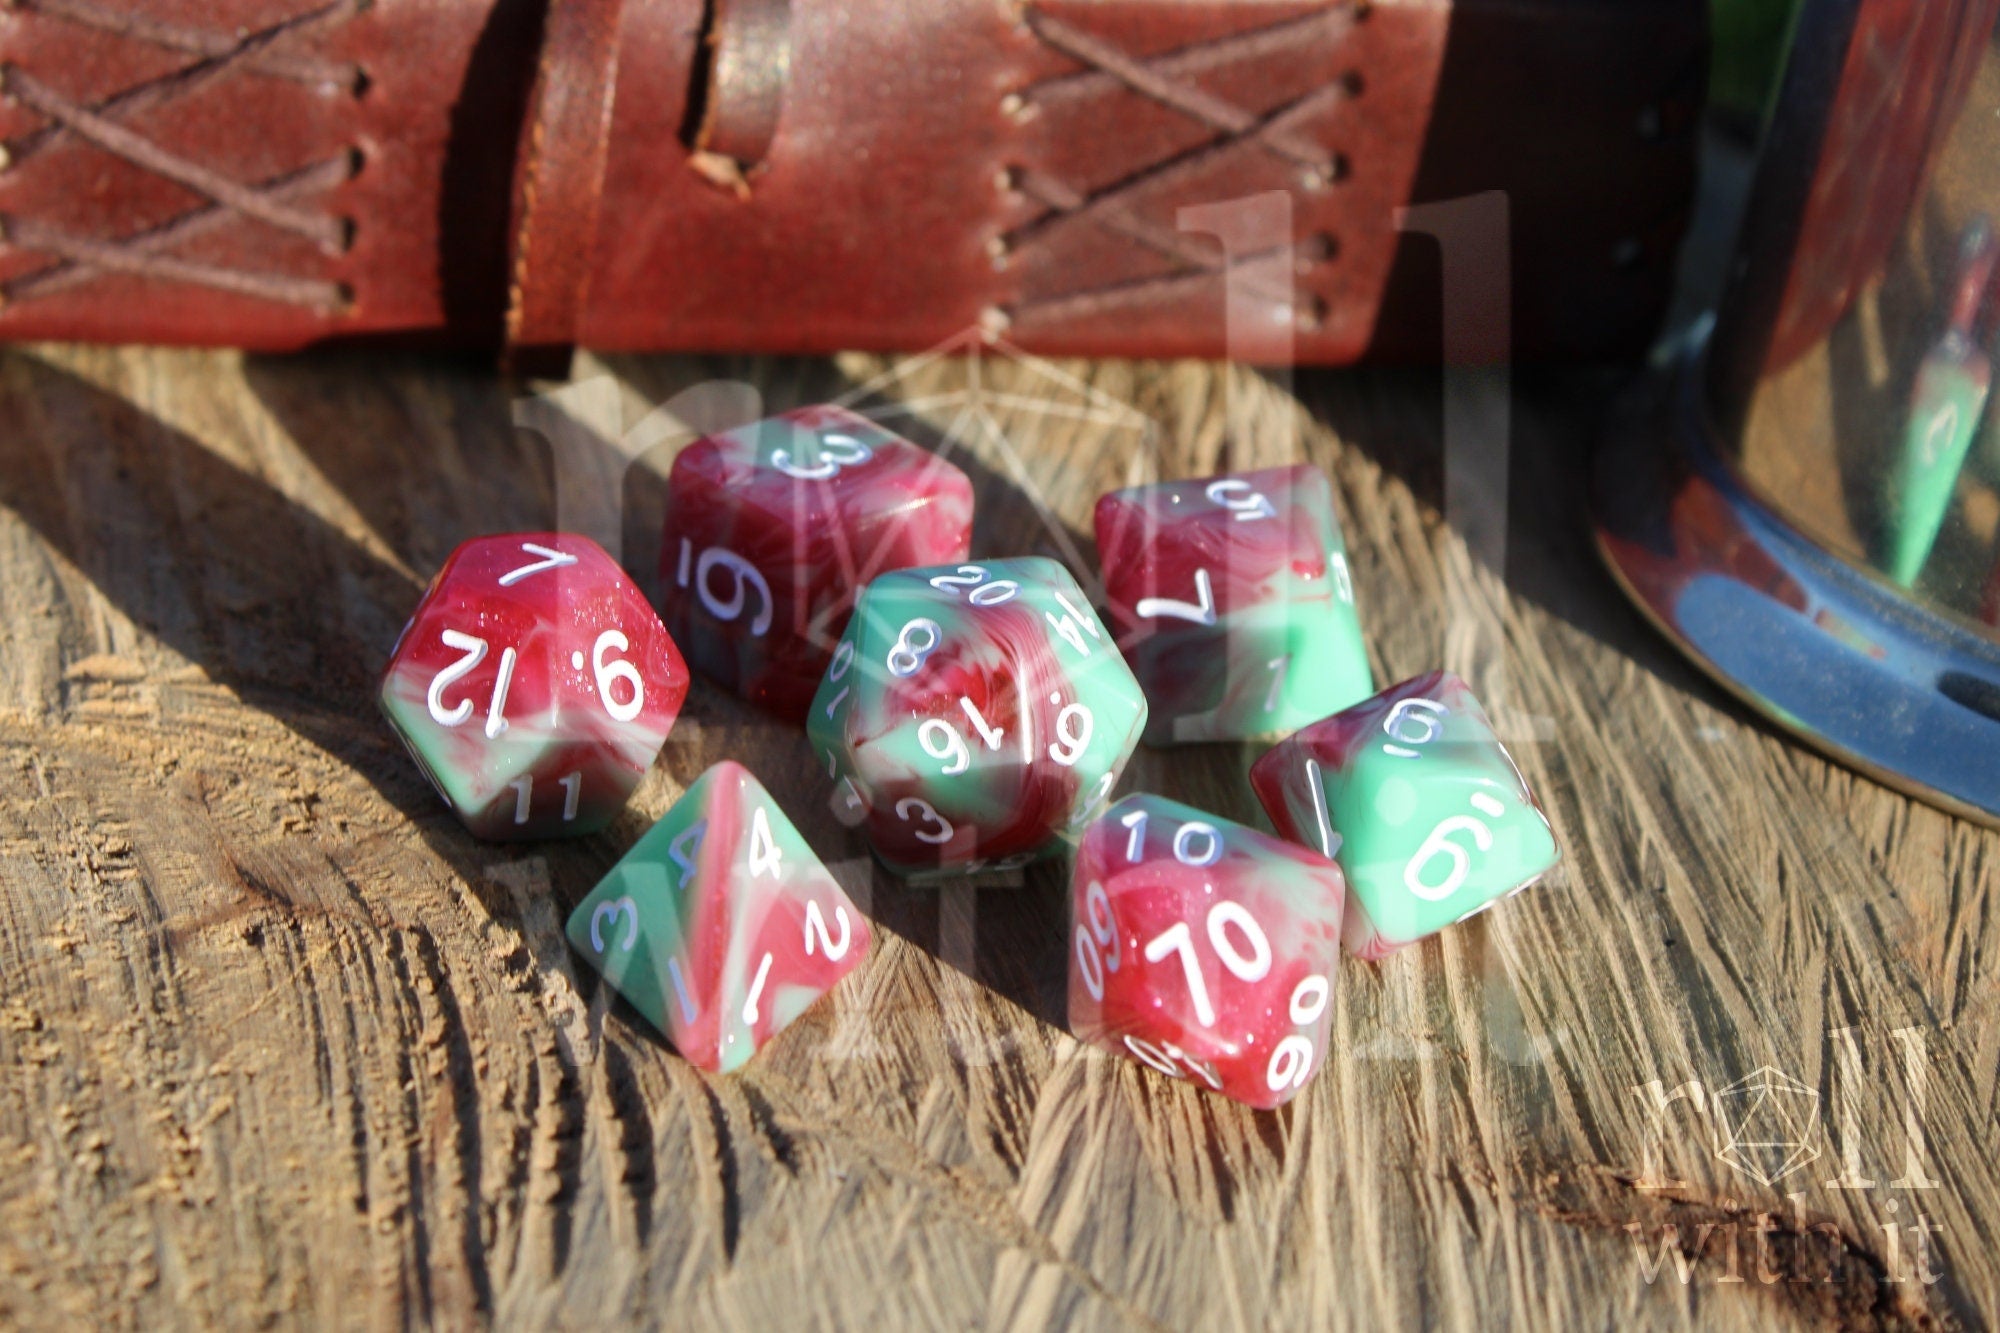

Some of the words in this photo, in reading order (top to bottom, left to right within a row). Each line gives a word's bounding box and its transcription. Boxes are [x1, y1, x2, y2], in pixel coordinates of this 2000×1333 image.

[771, 434, 872, 479] 3
[1205, 479, 1278, 521] 5
[498, 542, 578, 586] 7
[929, 565, 1023, 609] 20
[1045, 591, 1099, 657] 14
[1136, 568, 1218, 626] 7
[887, 618, 942, 677] 8
[427, 628, 516, 739] 12
[918, 697, 1004, 775] 16
[509, 771, 581, 824] 11
[896, 798, 954, 843] 3
[1306, 759, 1343, 859] 1
[668, 818, 708, 889] 4
[750, 806, 782, 879] 4
[1122, 811, 1223, 866] 10
[591, 896, 638, 953] 3
[805, 900, 850, 961] 2
[668, 955, 697, 1025] 1
[742, 952, 772, 1025] 1
[1145, 901, 1272, 1027] 70
